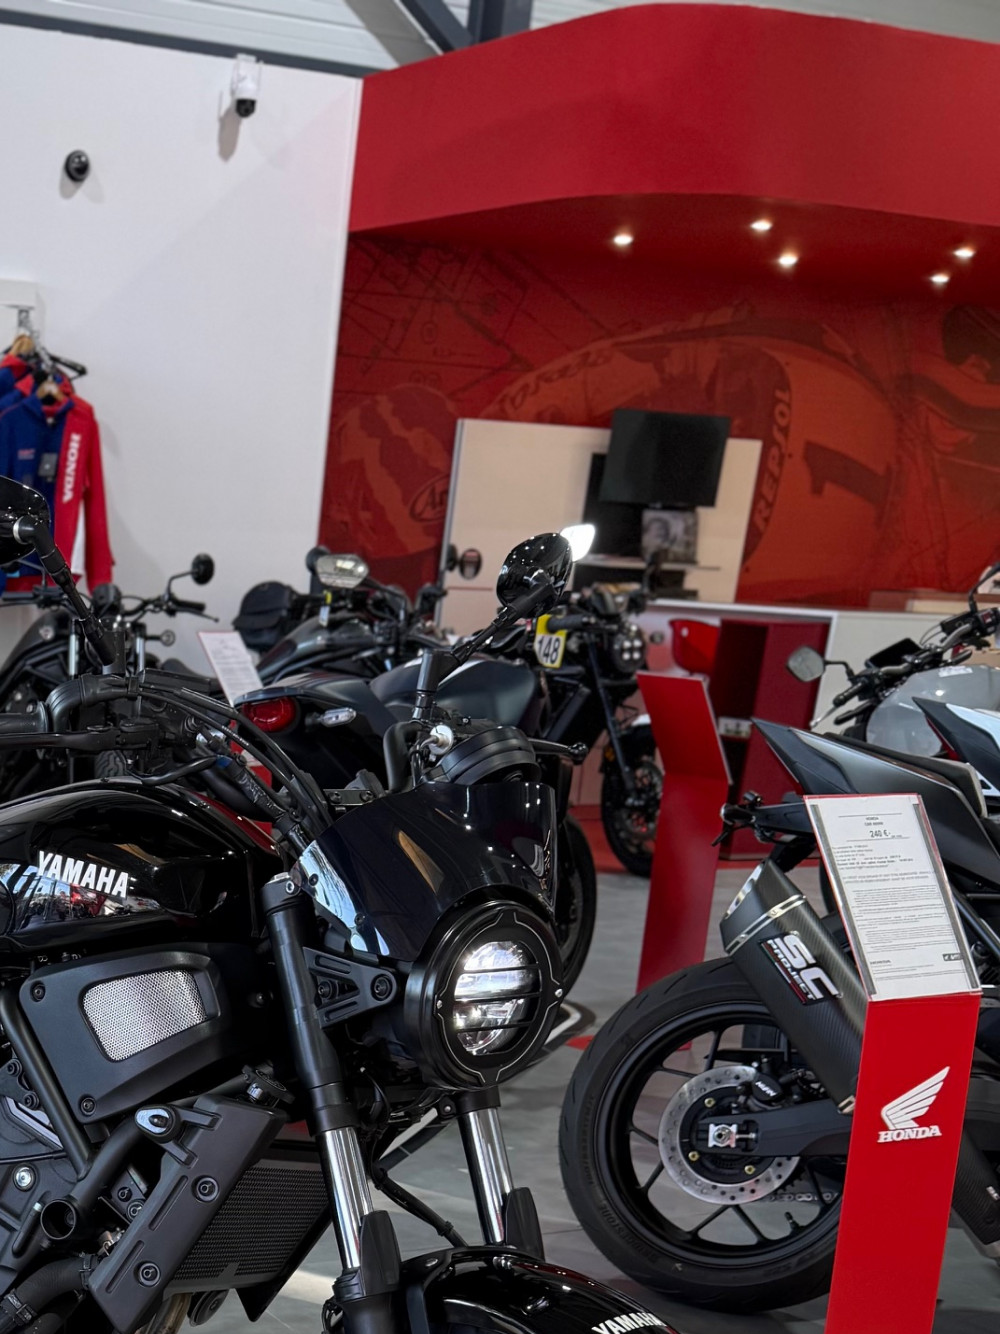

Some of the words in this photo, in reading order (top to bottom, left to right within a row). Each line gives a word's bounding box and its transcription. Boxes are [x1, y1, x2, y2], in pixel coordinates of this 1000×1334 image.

[62, 433, 82, 503] HONDA
[753, 389, 790, 532] REPSOL
[538, 636, 561, 664] 148
[869, 829, 883, 838] 240
[38, 850, 129, 898] YAMAHA
[877, 1125, 942, 1143] HONDA
